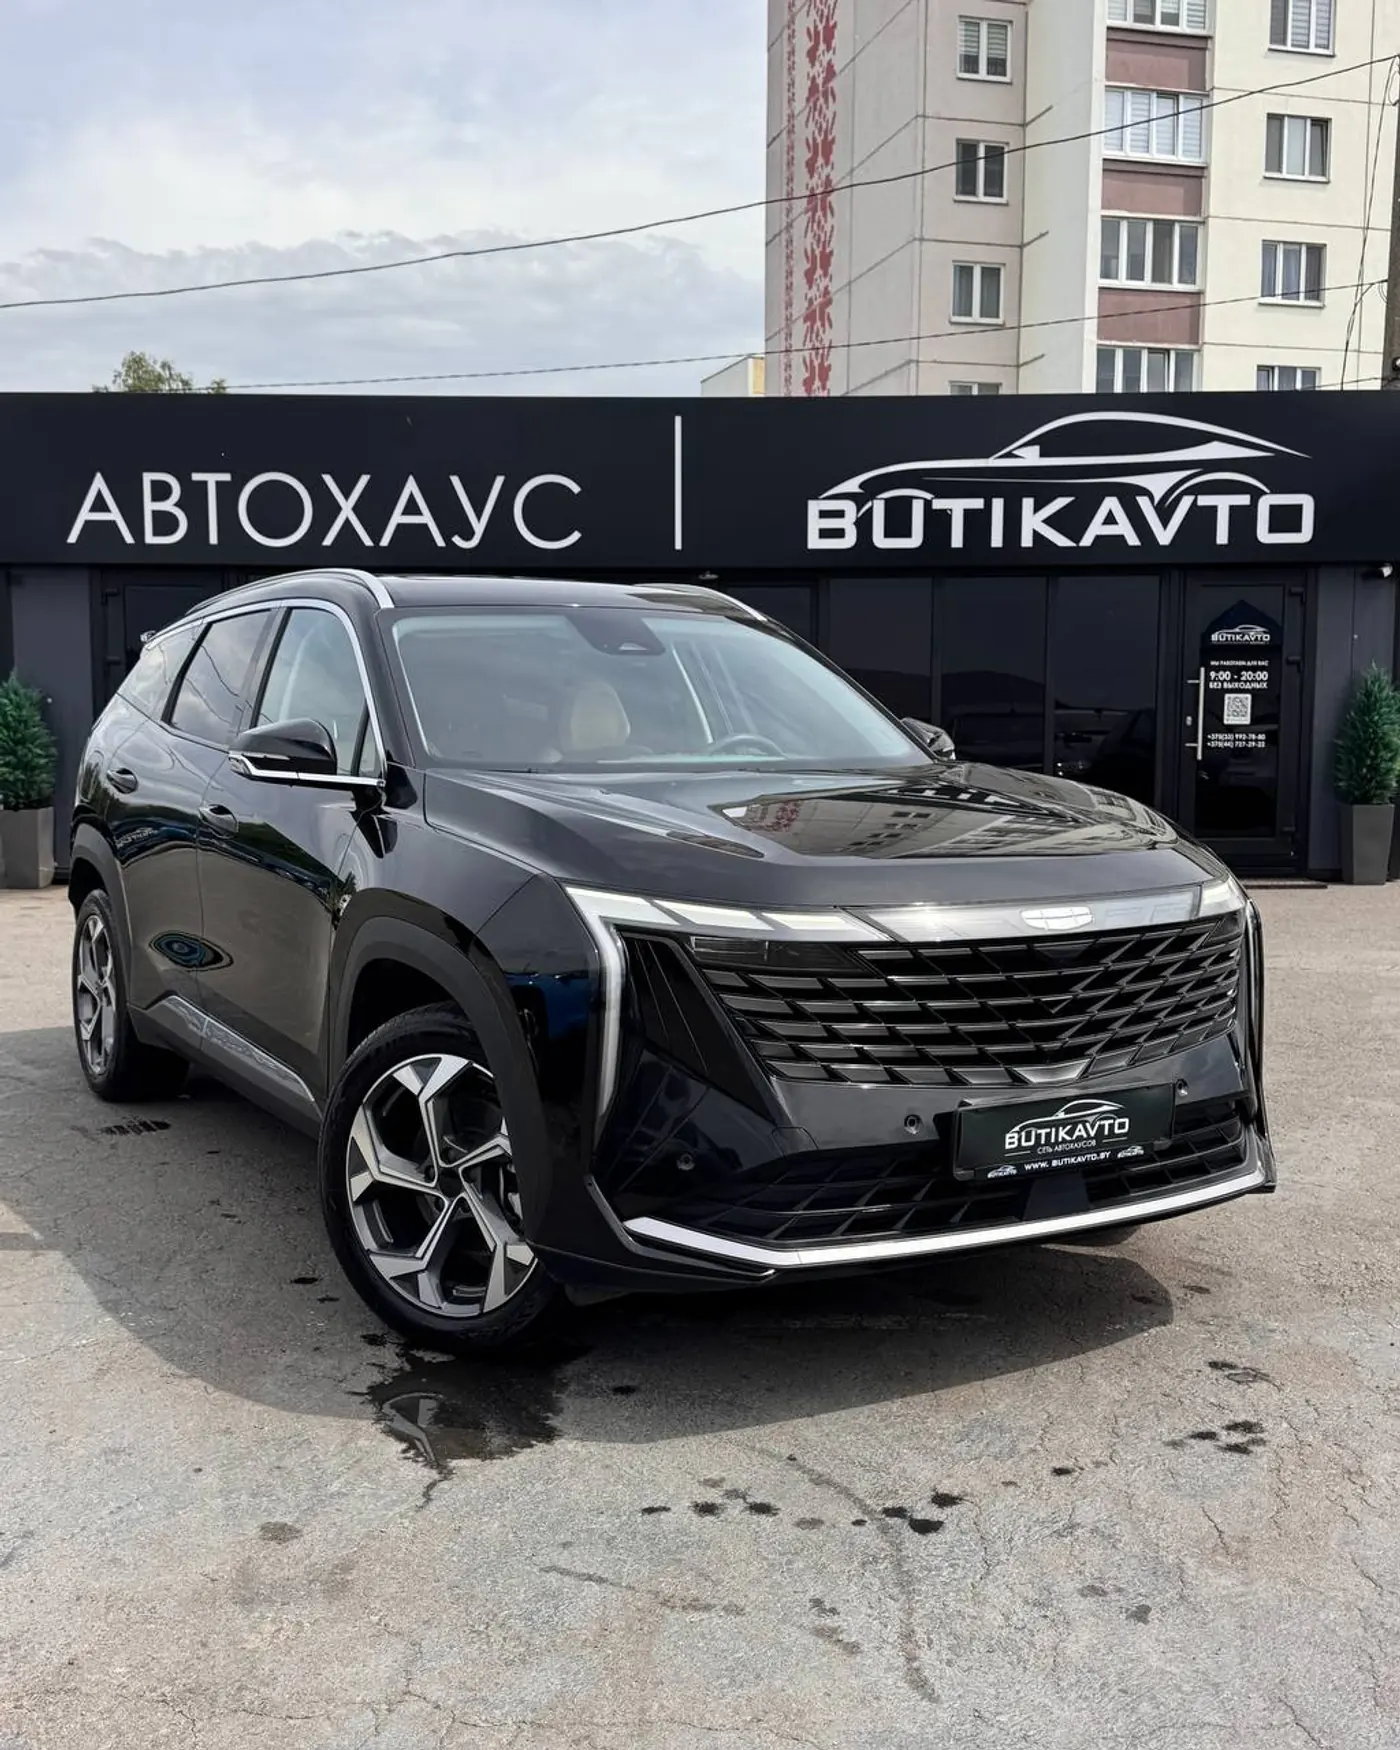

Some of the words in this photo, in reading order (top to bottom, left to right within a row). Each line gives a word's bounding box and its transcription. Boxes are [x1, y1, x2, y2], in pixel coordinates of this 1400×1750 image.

[66, 471, 583, 549] АВТОХАУС
[806, 493, 1315, 550] BUTIKAVTO
[1209, 681, 1222, 689] БЕЗ
[1223, 681, 1268, 689] ВЫХОДНЫХ
[1210, 670, 1231, 681] 9:00
[1240, 670, 1269, 681] 20:00
[1004, 1117, 1129, 1150] BUTIKAVTO
